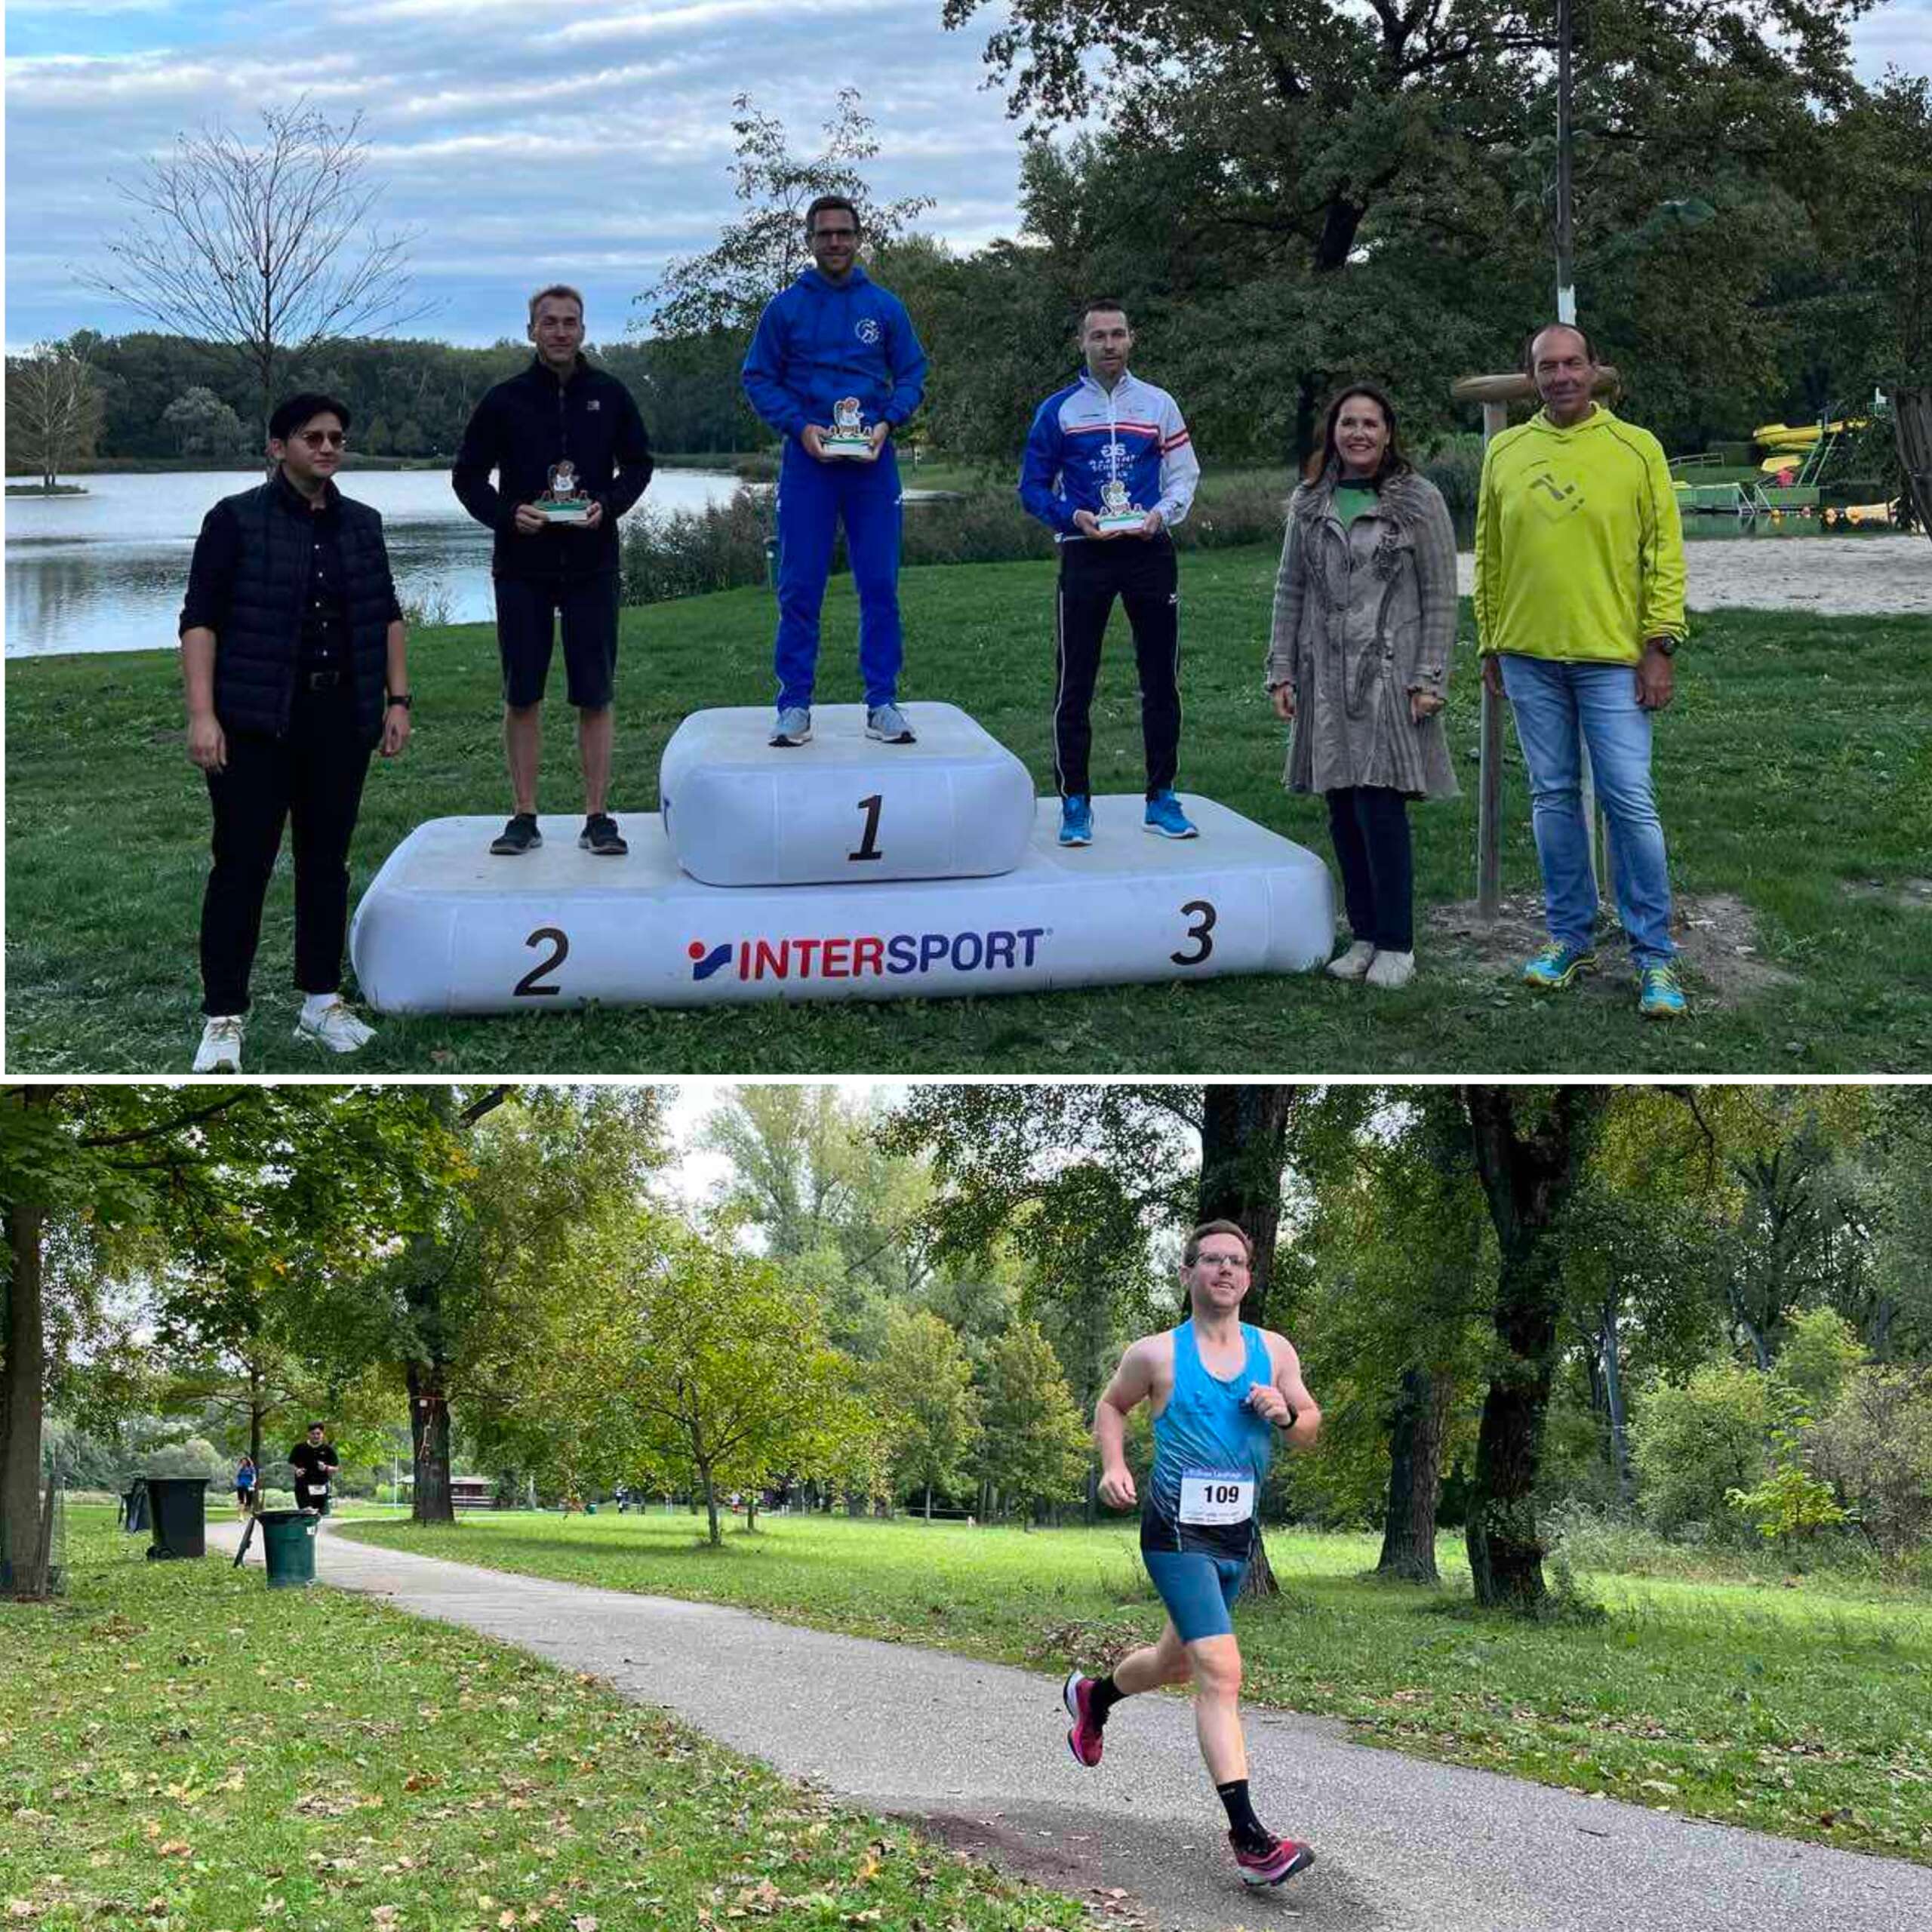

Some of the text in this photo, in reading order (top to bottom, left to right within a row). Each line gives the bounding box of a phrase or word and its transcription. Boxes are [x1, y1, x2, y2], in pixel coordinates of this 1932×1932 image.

[848, 795, 883, 861] 1
[513, 928, 570, 997] 2
[740, 929, 1044, 980] INTERSPORT
[1170, 900, 1217, 965] 3
[1204, 1485, 1239, 1503] 109
